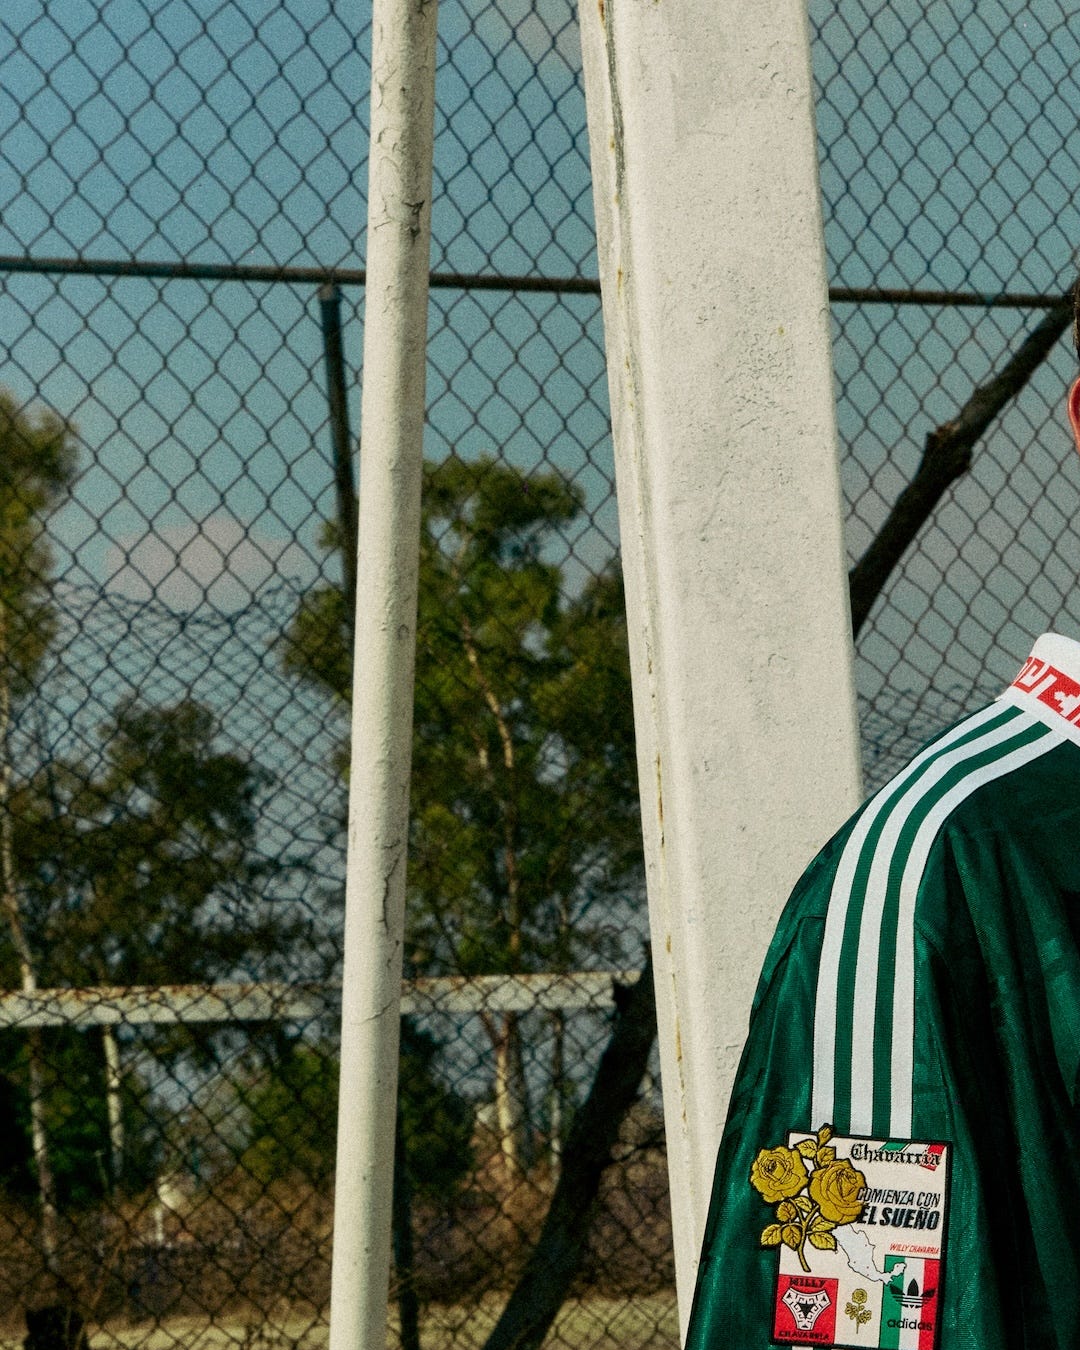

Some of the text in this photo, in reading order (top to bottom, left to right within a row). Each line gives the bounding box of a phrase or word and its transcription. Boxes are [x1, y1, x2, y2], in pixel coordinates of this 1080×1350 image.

[851, 1143, 940, 1166] Chavarria
[857, 1187, 941, 1208] COMIENZA CON
[880, 1206, 940, 1230] SUEÑO
[789, 1277, 826, 1288] WILLY
[887, 1318, 933, 1331] adidas
